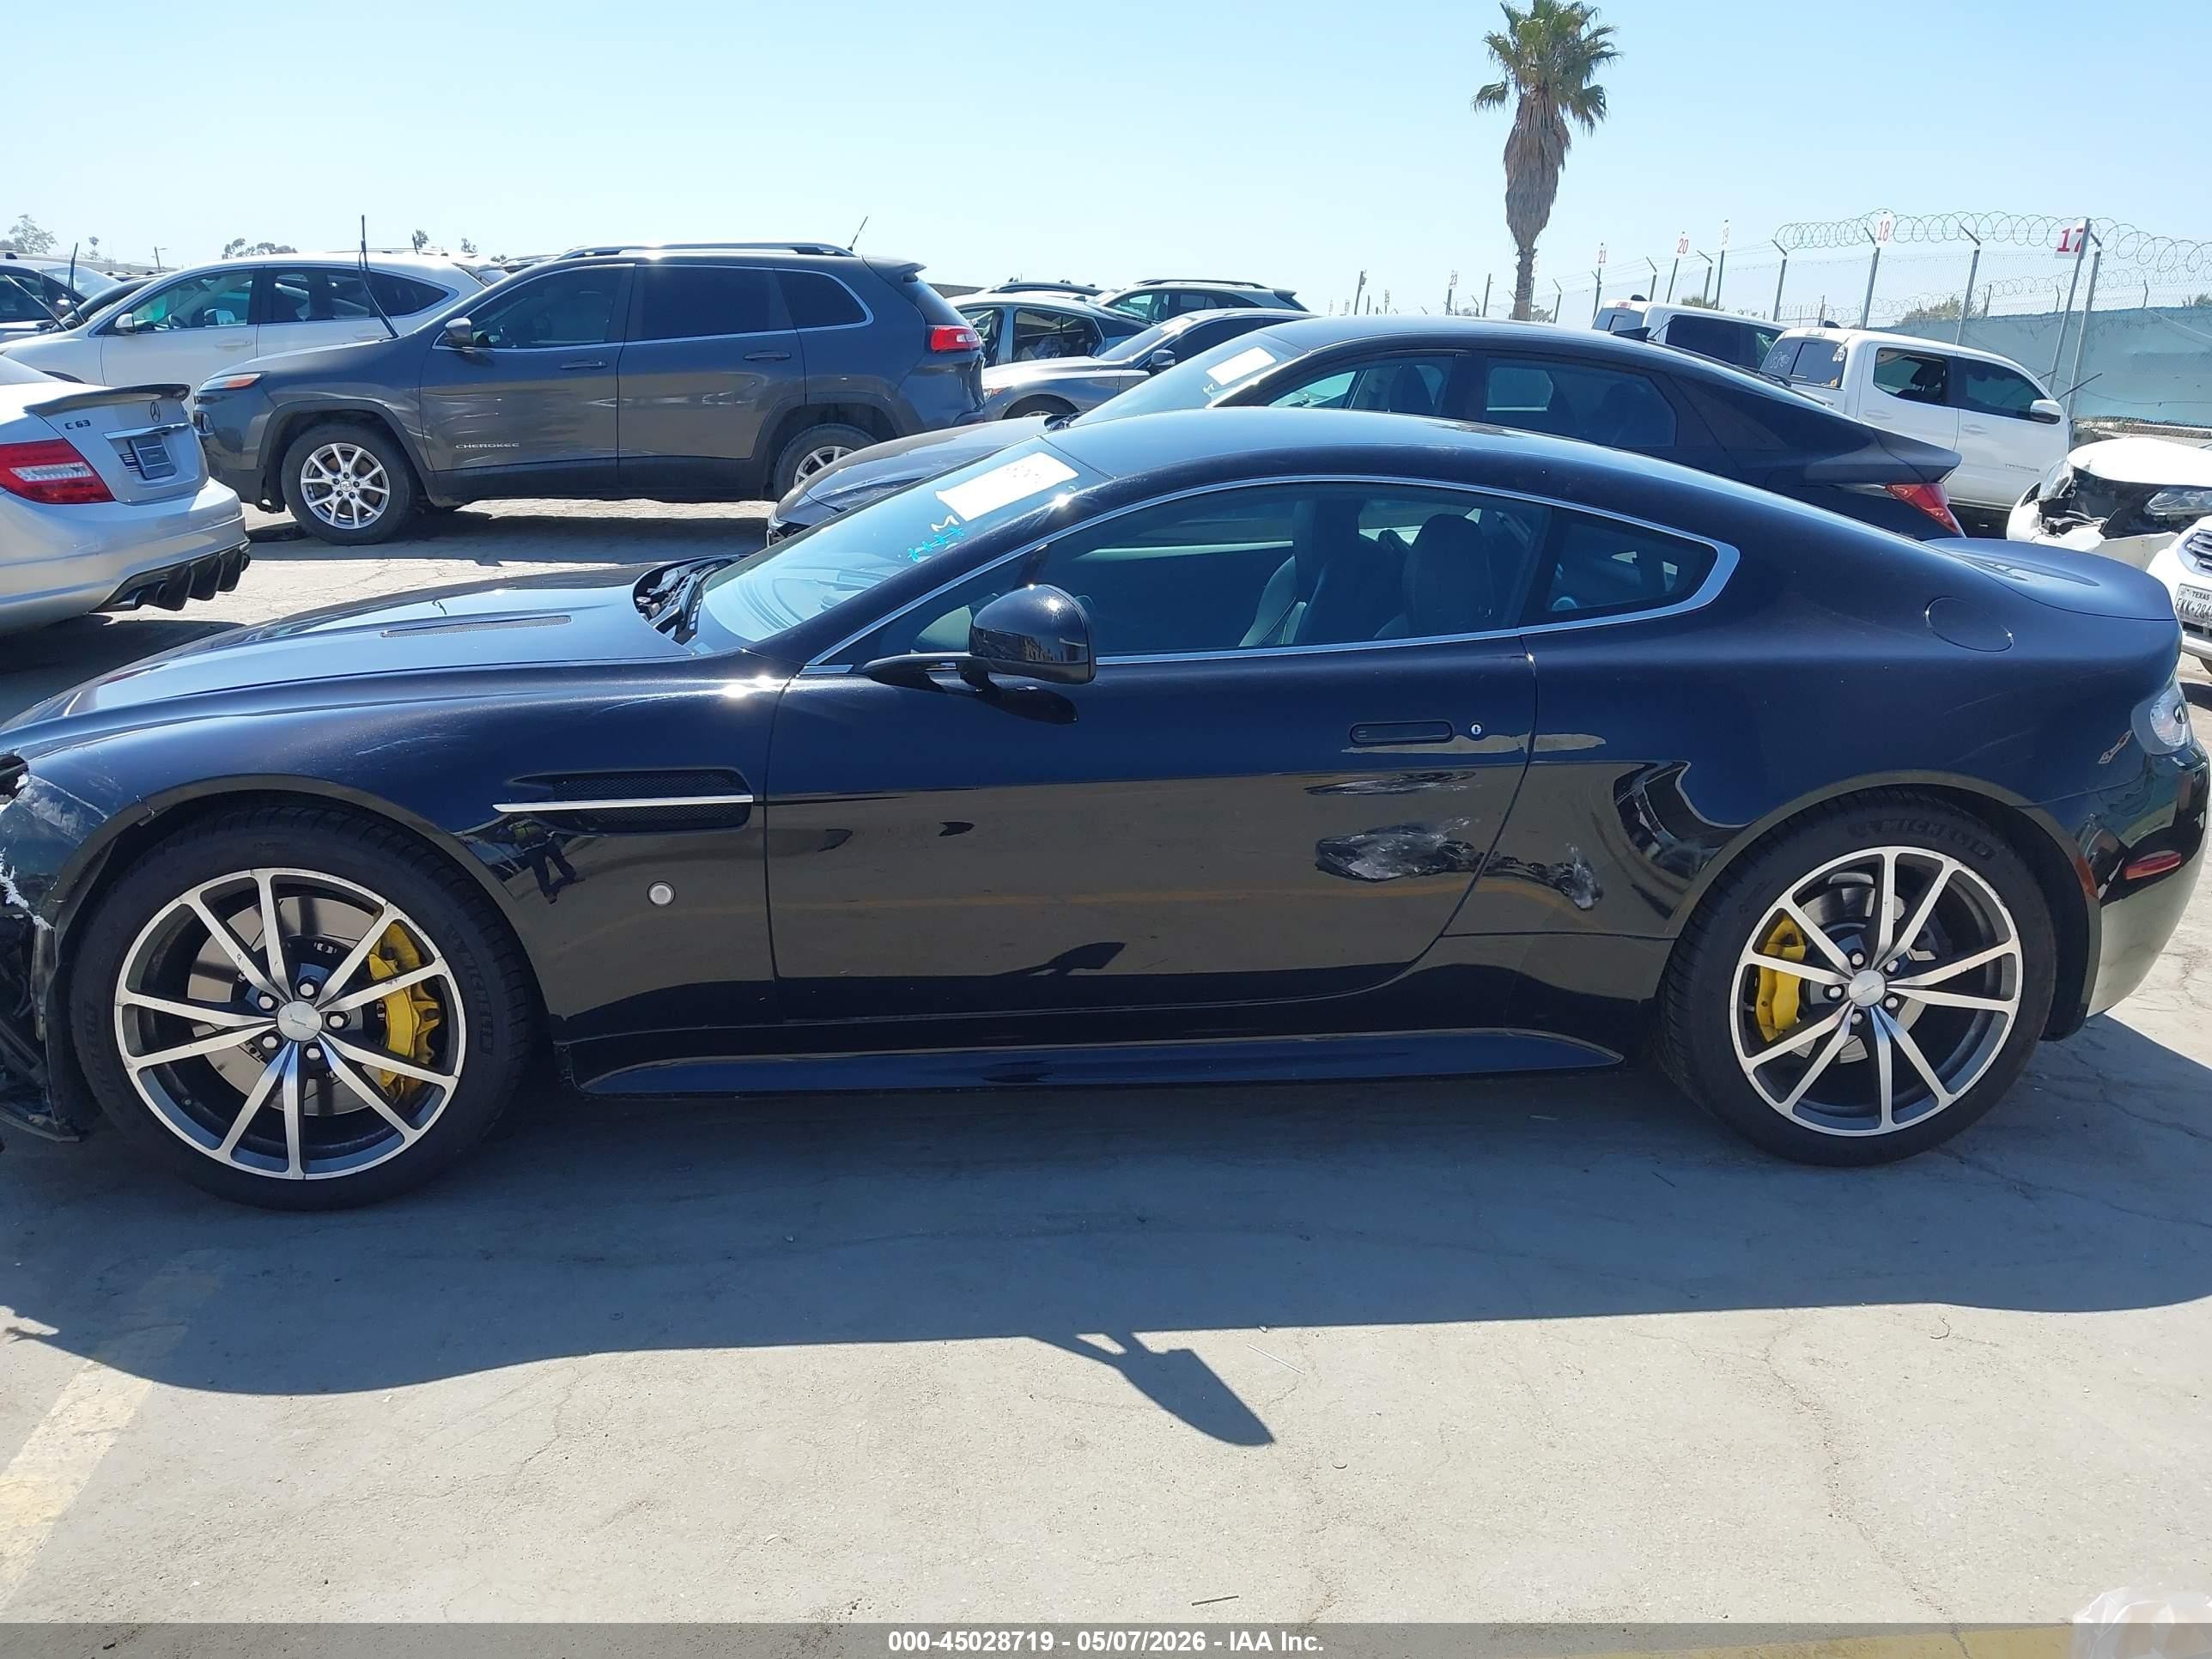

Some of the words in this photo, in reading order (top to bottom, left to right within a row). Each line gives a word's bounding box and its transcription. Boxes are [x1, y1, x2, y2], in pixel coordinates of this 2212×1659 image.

[1877, 221, 1890, 241] 18
[1677, 238, 1689, 254] 20
[2057, 228, 2084, 252] 17
[1598, 250, 1607, 264] 21
[75, 419, 91, 428] 63
[2191, 591, 2210, 601] TEXAS
